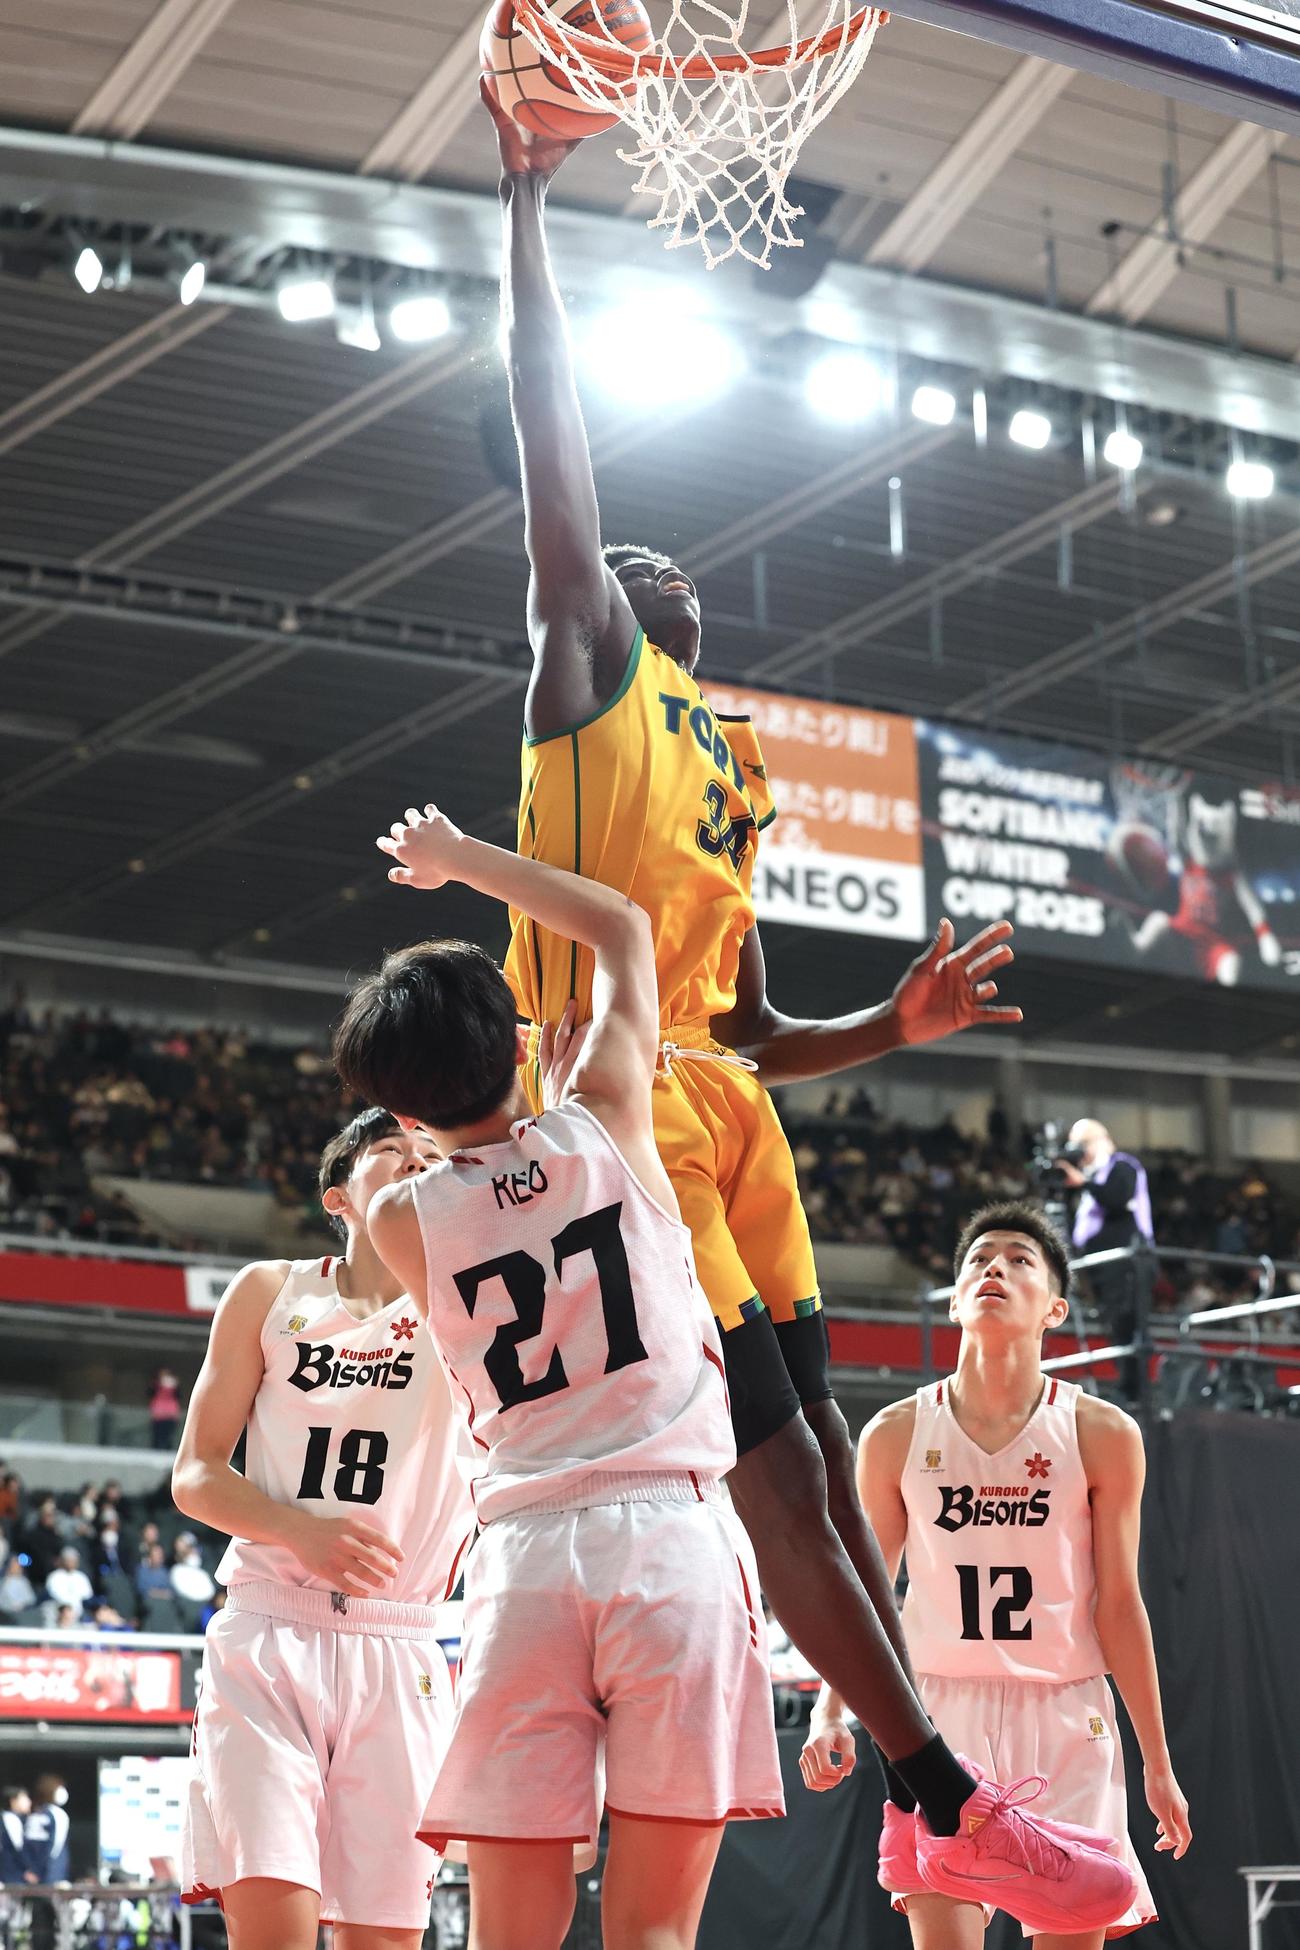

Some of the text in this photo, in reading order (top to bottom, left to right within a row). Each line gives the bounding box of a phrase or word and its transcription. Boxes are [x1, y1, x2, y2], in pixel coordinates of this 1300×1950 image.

[695, 779, 758, 876] 34
[942, 876, 1014, 921] CUP
[452, 1201, 649, 1414] 27
[339, 1347, 394, 1361] KUROKO
[296, 1427, 389, 1505] 18
[979, 1486, 1029, 1496] KUROKO
[954, 1565, 1033, 1640] 12
